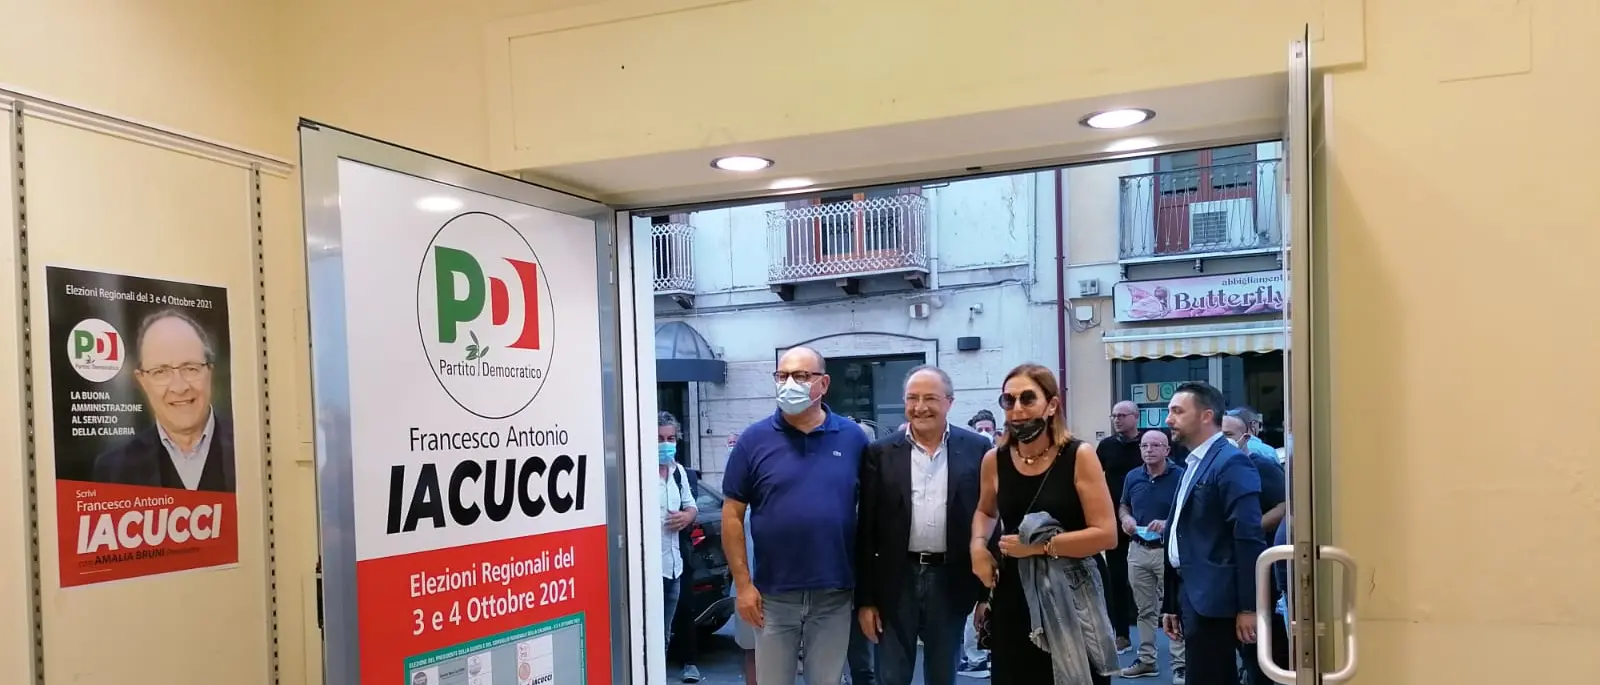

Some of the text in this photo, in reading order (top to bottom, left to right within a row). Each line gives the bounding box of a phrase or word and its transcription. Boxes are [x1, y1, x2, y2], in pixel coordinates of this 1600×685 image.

[1221, 273, 1283, 286] abbigliament
[65, 284, 213, 309] Elezioni Regionali del 3 e 4 Ottobre 2021
[434, 245, 540, 350] PD
[1174, 286, 1283, 311] Butterfly
[439, 359, 542, 379] Partito Democratico
[70, 391, 110, 400] LA BUONA
[1132, 382, 1177, 402] FUO
[71, 403, 143, 412] AMMINISTRAZIONE
[71, 415, 118, 424] AL SERVIZIO
[72, 426, 135, 436] DELLA CALABRIA
[409, 424, 569, 452] Francesco Antonio
[76, 489, 97, 499] Scrivi
[76, 495, 174, 512] Francesco Antonio
[386, 454, 588, 535] IACUCCI
[76, 503, 222, 555] IACUCCI
[94, 553, 134, 565] AMALIA
[135, 547, 165, 560] BRUNI
[410, 546, 575, 598] Elezioni Regionali del
[412, 577, 576, 636] 3 e 4 Ottobre 2021
